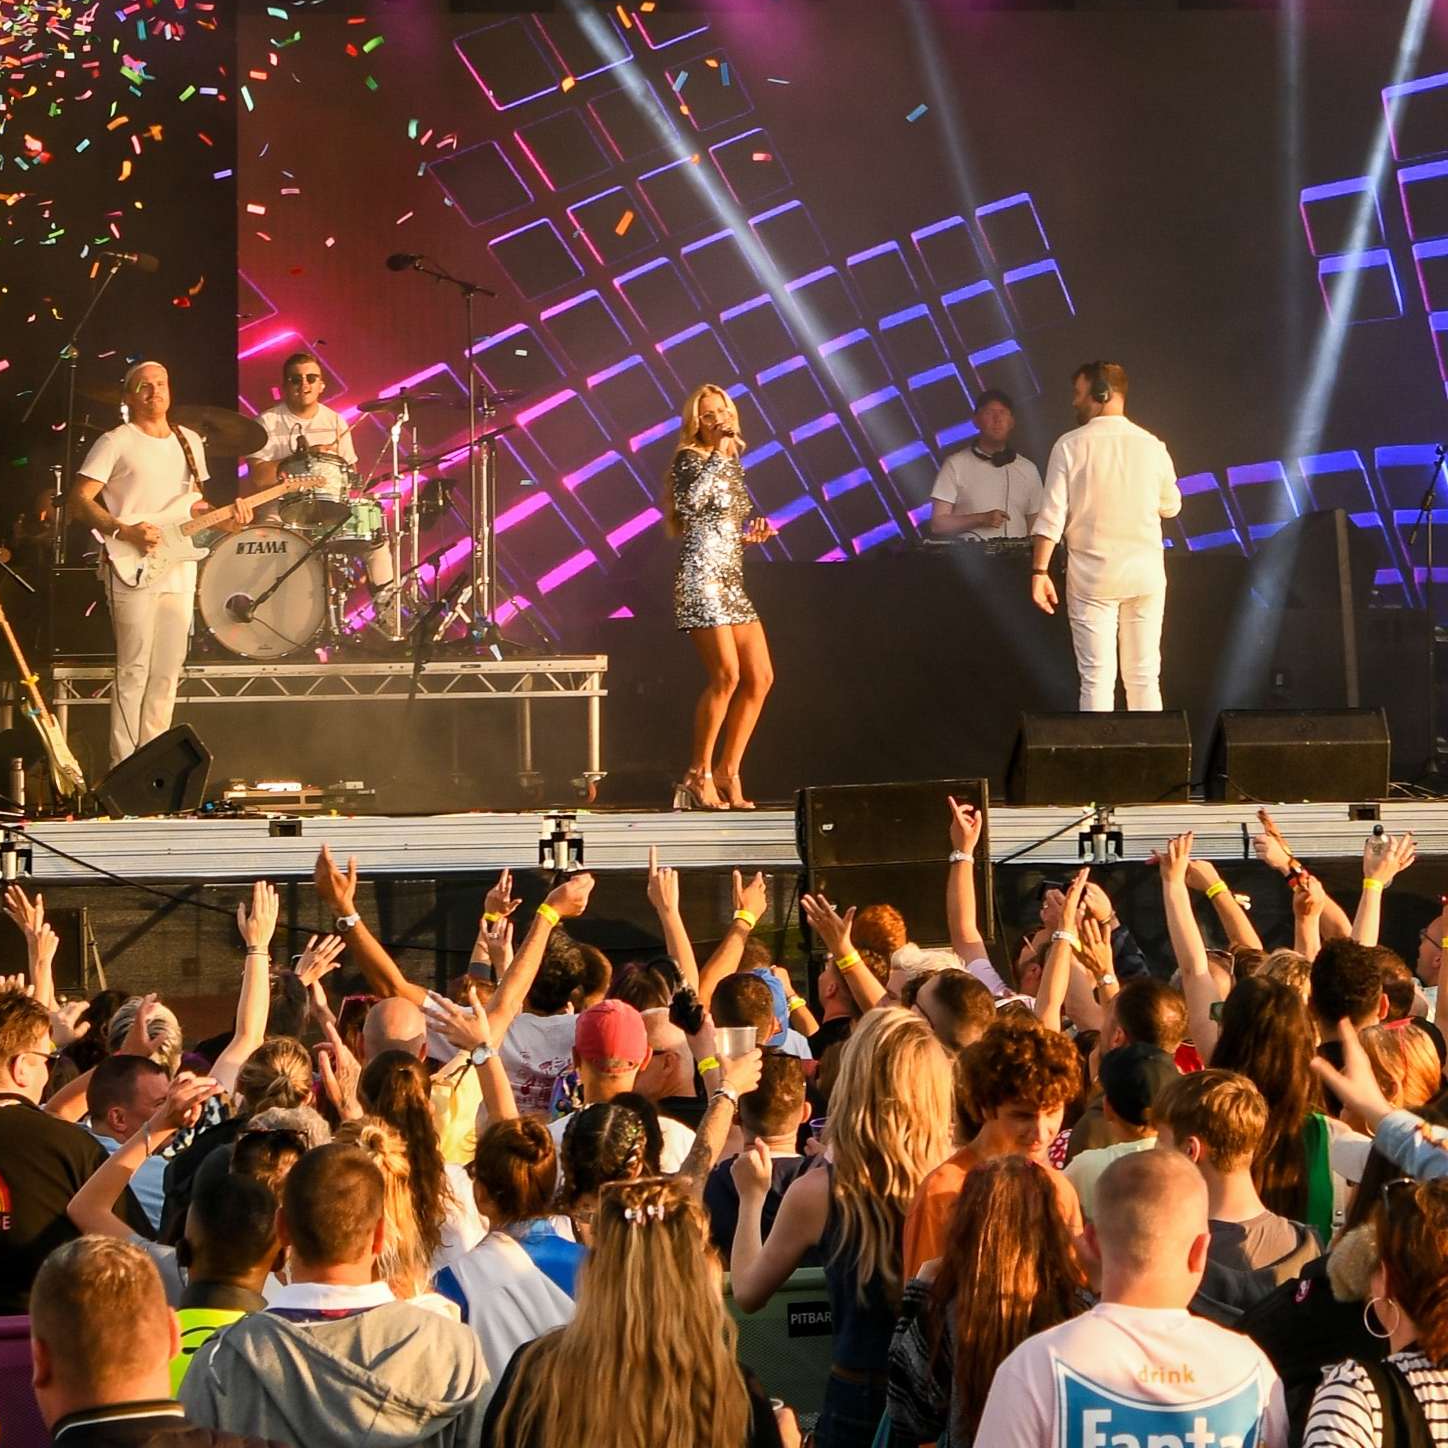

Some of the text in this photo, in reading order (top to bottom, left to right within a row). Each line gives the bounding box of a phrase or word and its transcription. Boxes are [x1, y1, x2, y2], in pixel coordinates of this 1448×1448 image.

[244, 541, 288, 555] TAMA
[790, 1311, 832, 1325] PITBAR
[1138, 1363, 1195, 1384] drink
